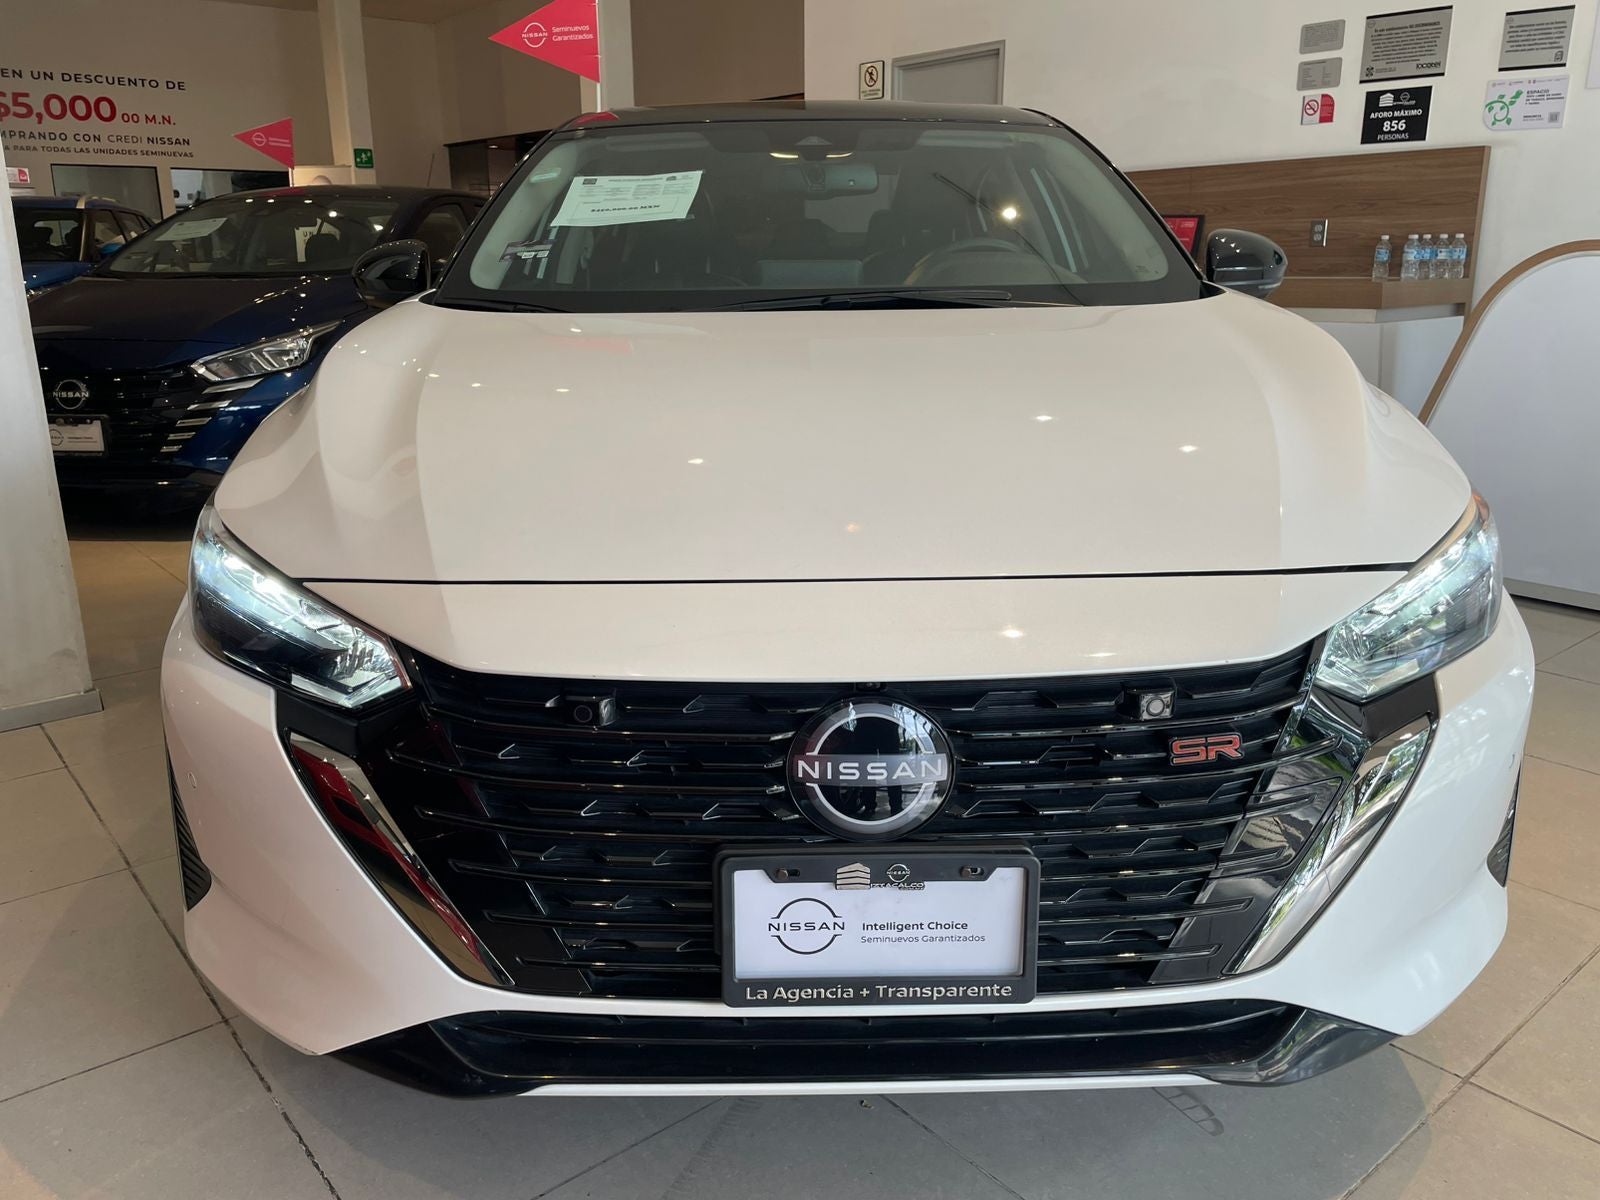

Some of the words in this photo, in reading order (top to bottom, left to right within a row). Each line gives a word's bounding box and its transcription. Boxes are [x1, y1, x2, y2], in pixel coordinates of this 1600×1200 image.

[551, 25, 590, 33] Seminuevos
[552, 33, 594, 42] Garantizados
[30, 70, 54, 81] UN
[61, 72, 159, 89] DESCUENTO
[165, 80, 187, 91] DE
[121, 112, 140, 124] 00
[145, 114, 176, 126] M.N.
[1370, 111, 1393, 119] AFORO
[1393, 108, 1423, 117] MÁXIMO
[1382, 120, 1406, 132] 856
[73, 133, 101, 143] CON
[107, 134, 143, 144] CREDI
[146, 136, 191, 147] NISSAN
[1377, 133, 1409, 141] PERSONAS
[93, 148, 138, 156] UNIDADES
[140, 150, 194, 158] SEMINUEVAS
[1171, 733, 1243, 765] SR
[797, 759, 942, 780] NISSAN
[768, 921, 845, 932] NISSAN
[862, 920, 925, 933] Intelligent
[927, 920, 968, 932] Choice
[860, 935, 919, 944] Seminuevos
[921, 934, 986, 944] Garantizados
[746, 986, 768, 1000] La
[773, 984, 854, 1003] Agencia
[859, 987, 870, 999] +
[875, 983, 1012, 1003] Transparente
